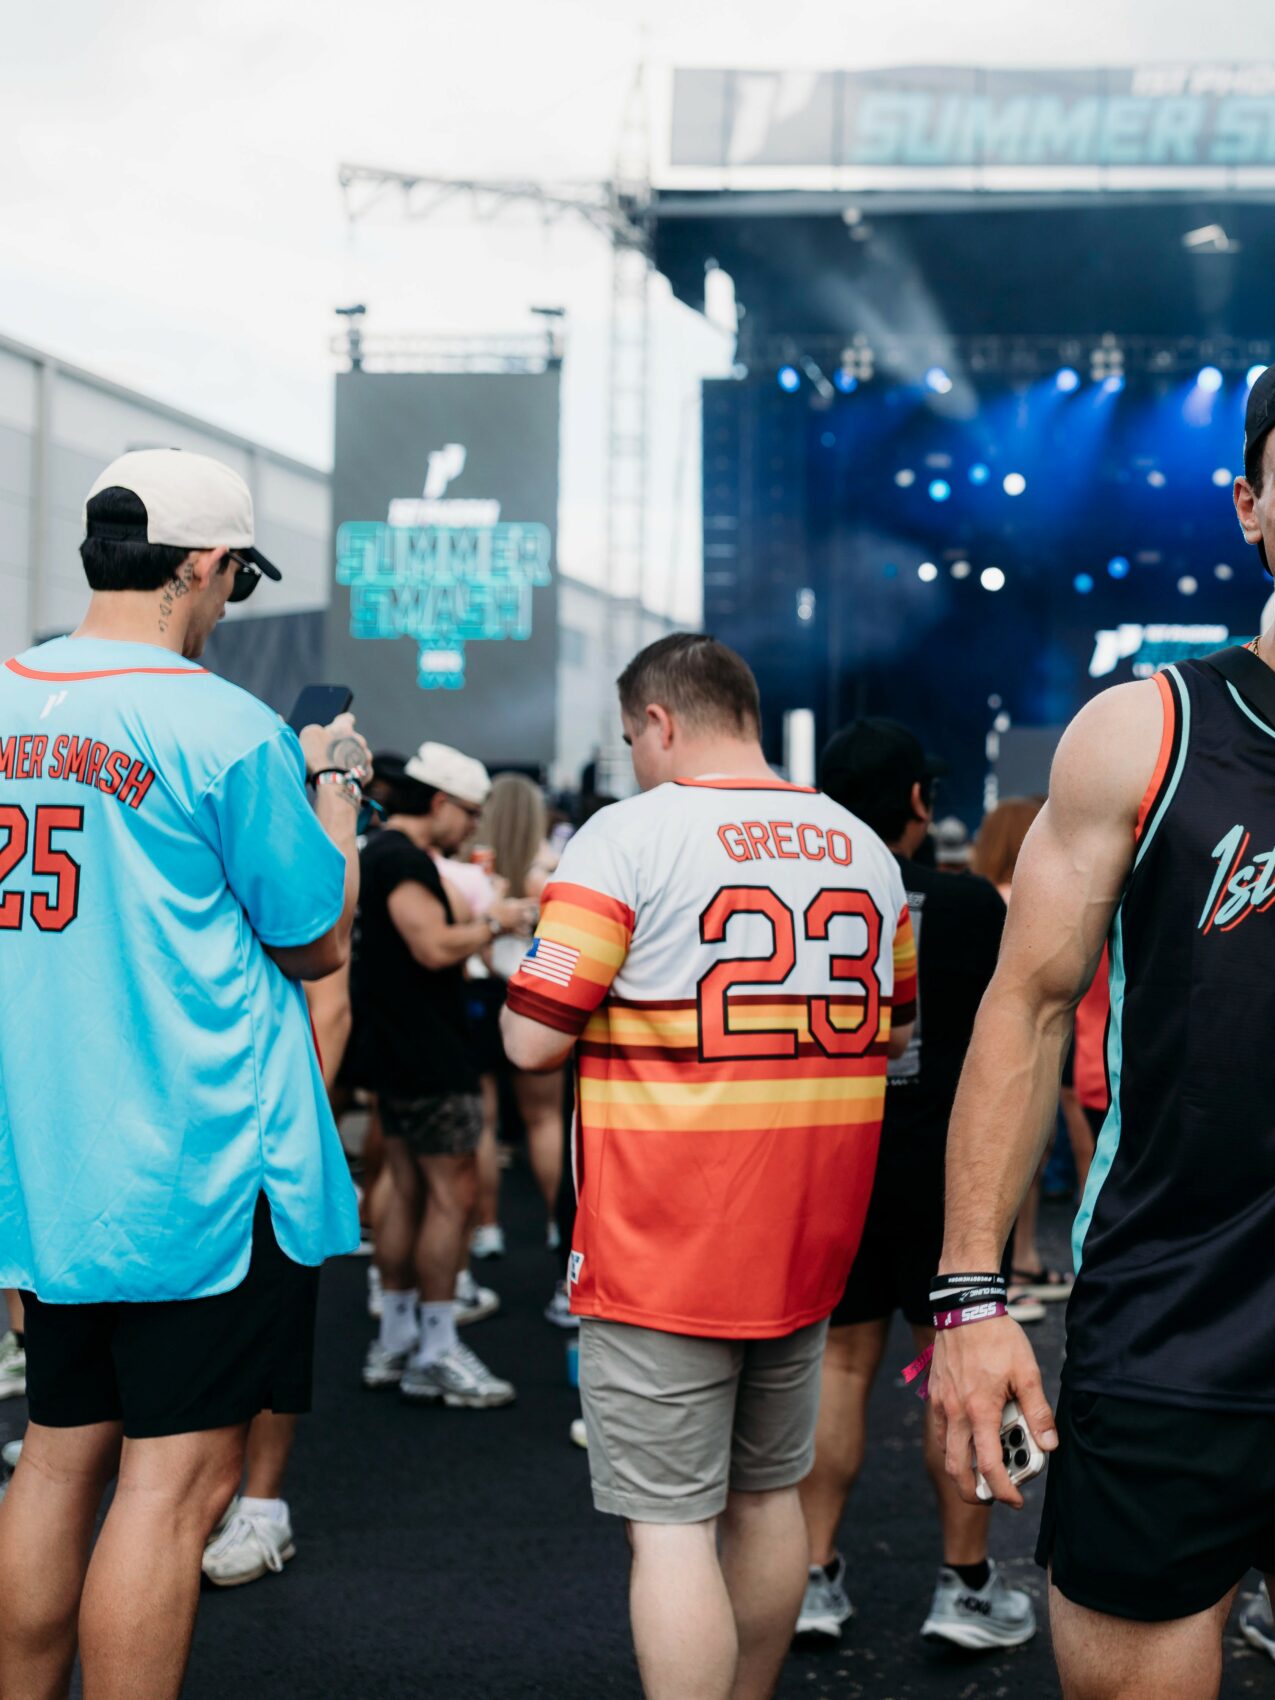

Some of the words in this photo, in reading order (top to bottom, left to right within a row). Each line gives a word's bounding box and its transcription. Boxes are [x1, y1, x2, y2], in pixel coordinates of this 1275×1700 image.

[853, 93, 1203, 163] SUMMER
[48, 735, 155, 810] SMASH
[716, 821, 853, 867] GRECO
[696, 885, 884, 1062] 23
[961, 1301, 997, 1322] SS25
